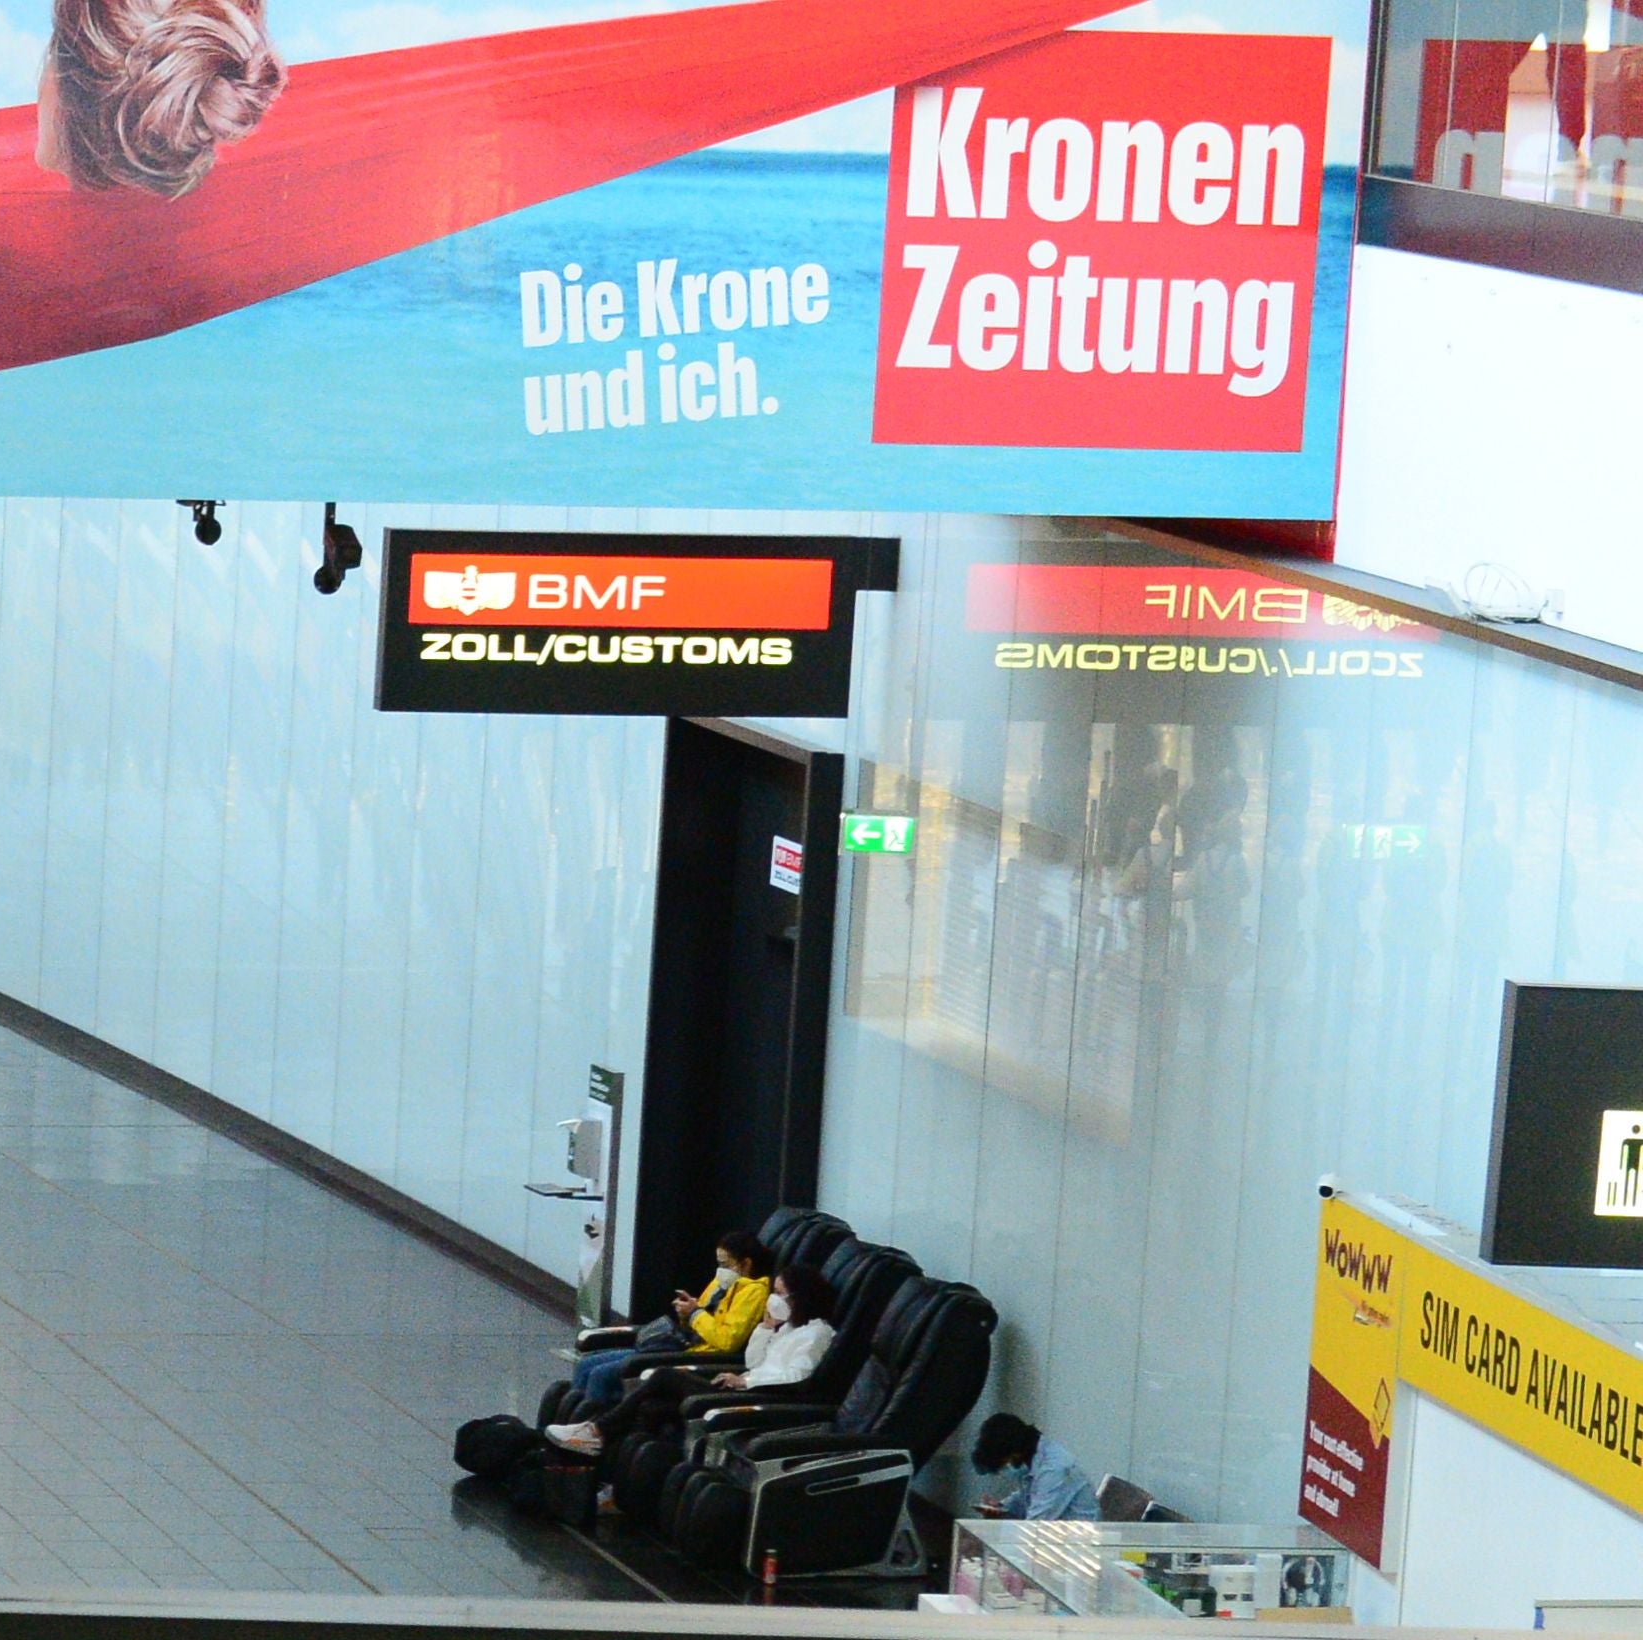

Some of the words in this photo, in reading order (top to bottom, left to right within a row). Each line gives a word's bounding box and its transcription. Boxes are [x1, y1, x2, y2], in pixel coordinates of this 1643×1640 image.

[906, 86, 1305, 226] Kronen
[519, 263, 625, 348] Die
[636, 258, 831, 338] Krone
[895, 239, 1295, 398] Zeitung
[523, 350, 646, 436] und
[657, 341, 780, 424] ich.
[528, 573, 667, 611] BMF
[420, 633, 793, 665] ZOLL/CUSTOMS
[1421, 1291, 1460, 1364] SIM
[1465, 1315, 1521, 1396] CARD
[1526, 1348, 1643, 1467] AVAILABLE
